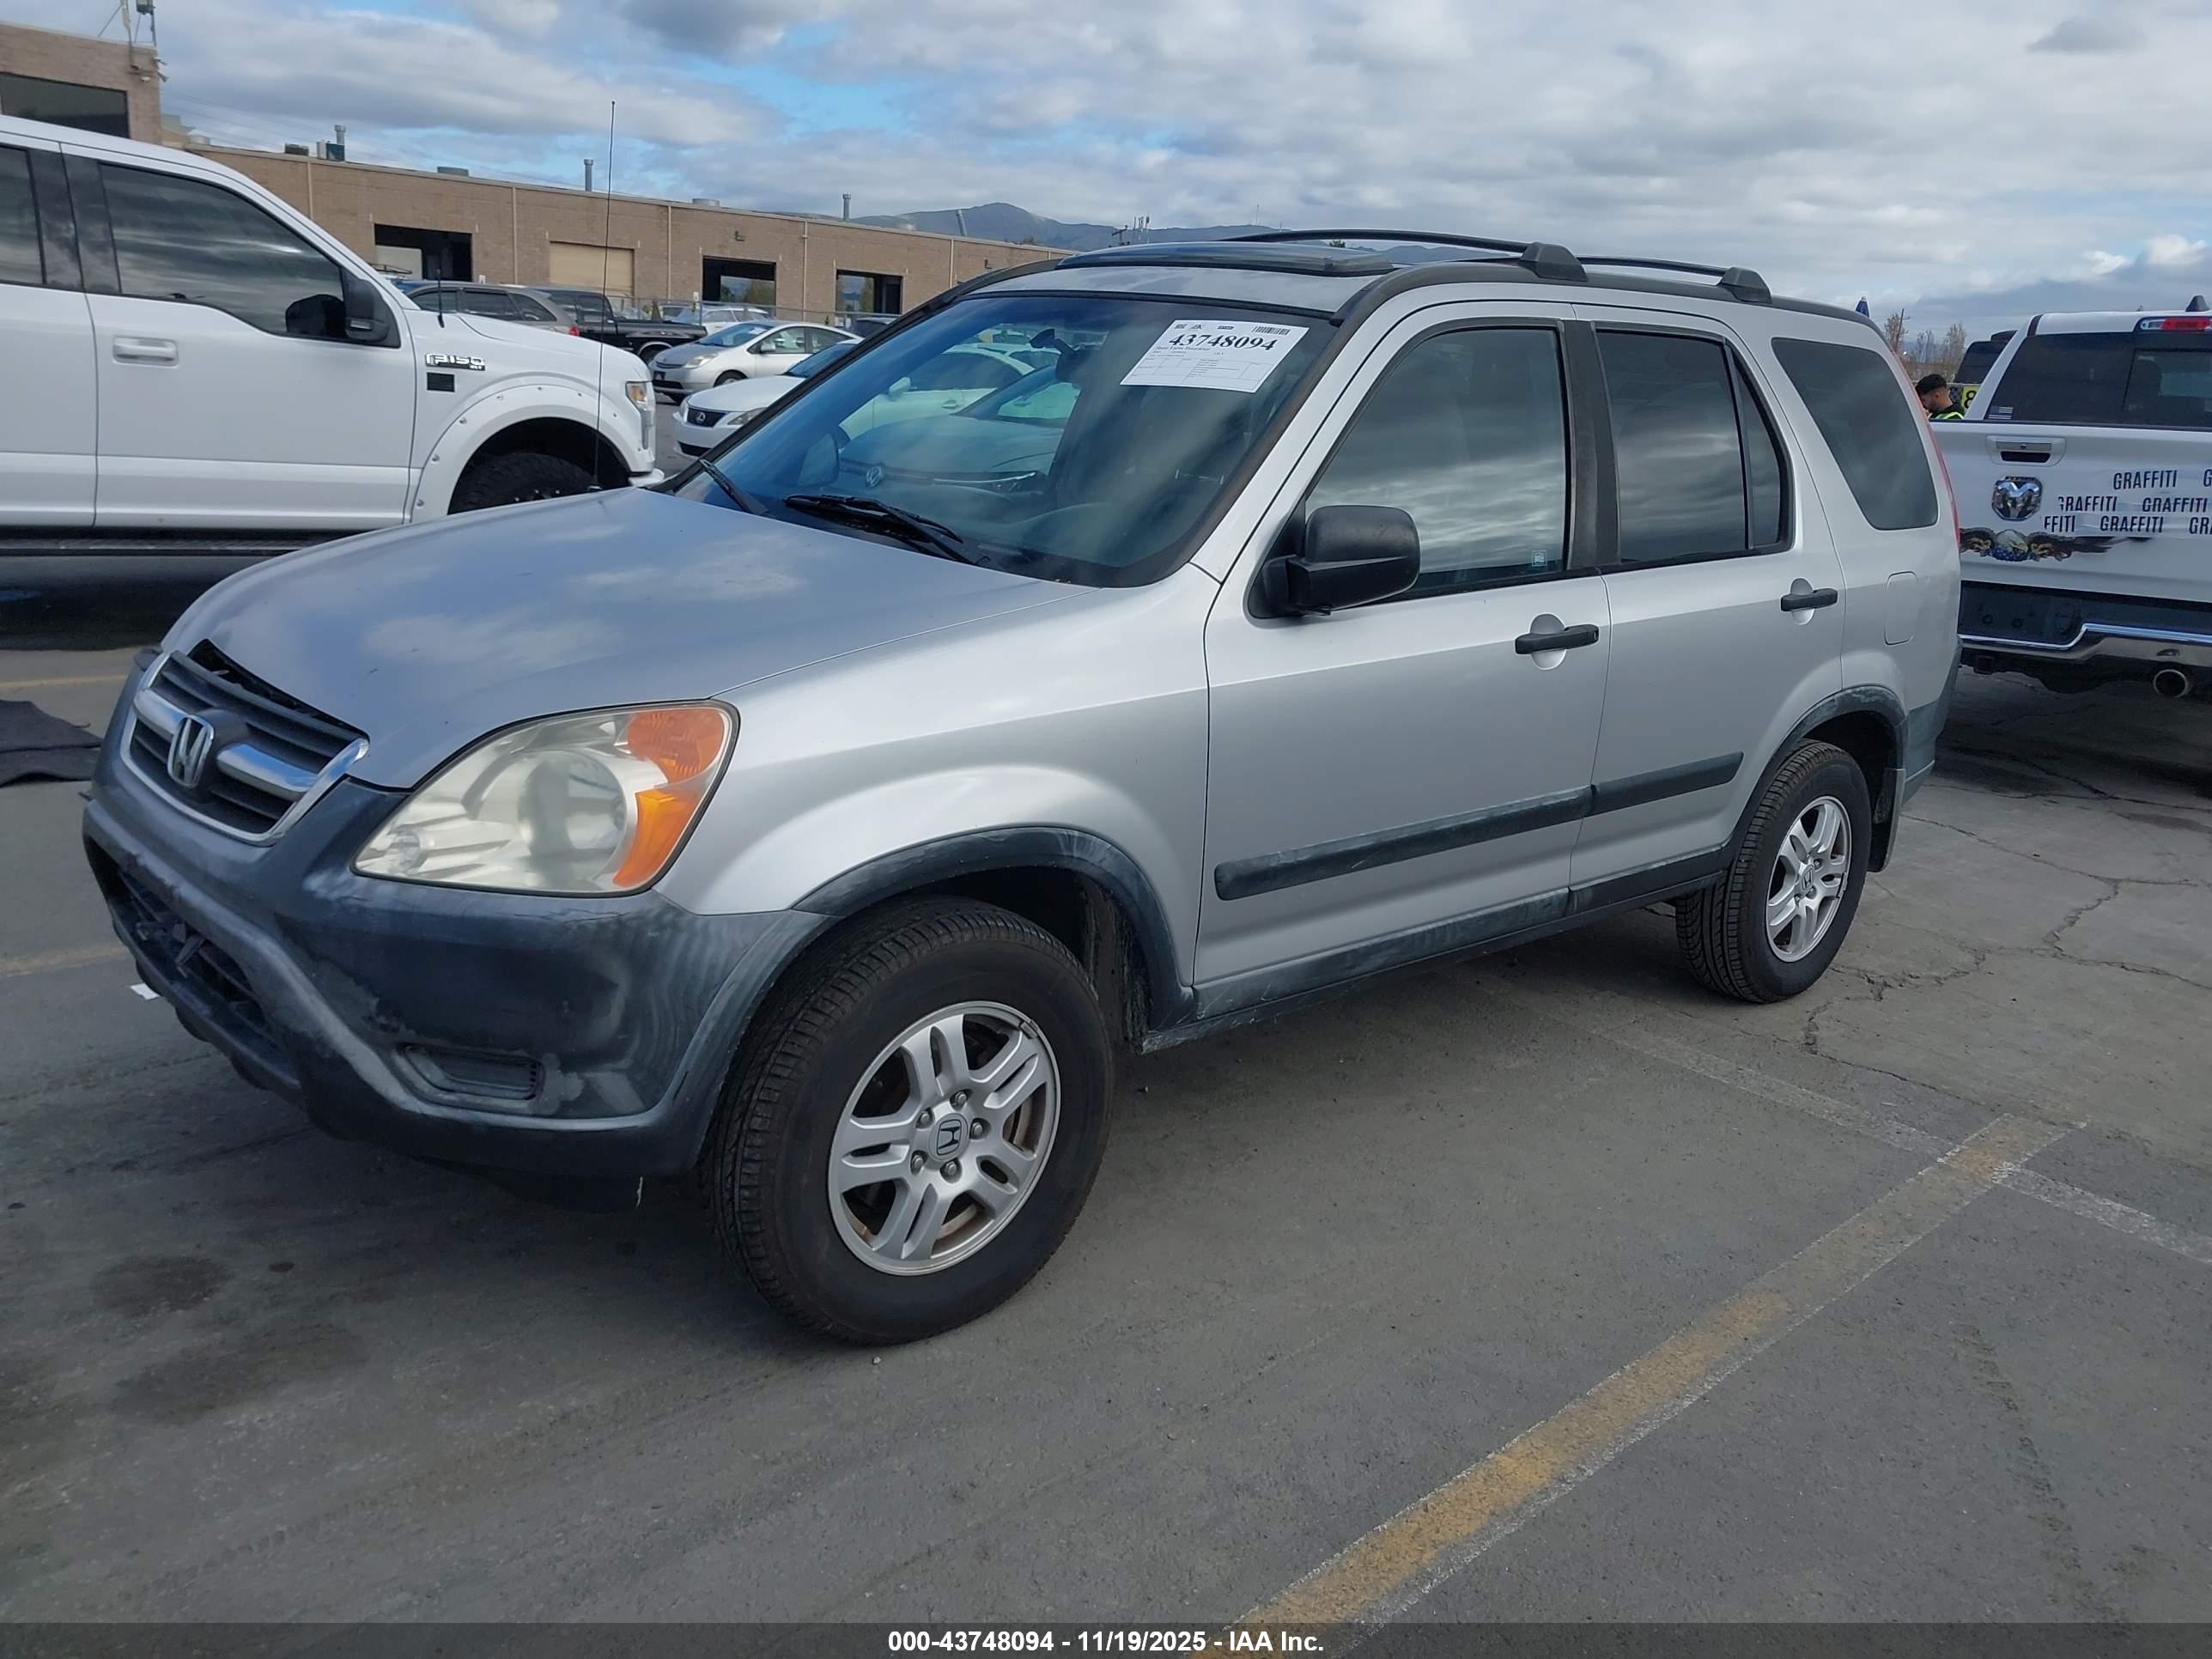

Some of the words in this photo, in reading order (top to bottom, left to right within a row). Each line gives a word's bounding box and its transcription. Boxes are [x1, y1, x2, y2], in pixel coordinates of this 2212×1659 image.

[1169, 333, 1278, 350] 43748094
[2113, 470, 2178, 490] GRAFFITI
[2142, 497, 2208, 513] GRAFFITI
[2100, 515, 2164, 532] GRAFFITI
[2189, 517, 2212, 535] GR
